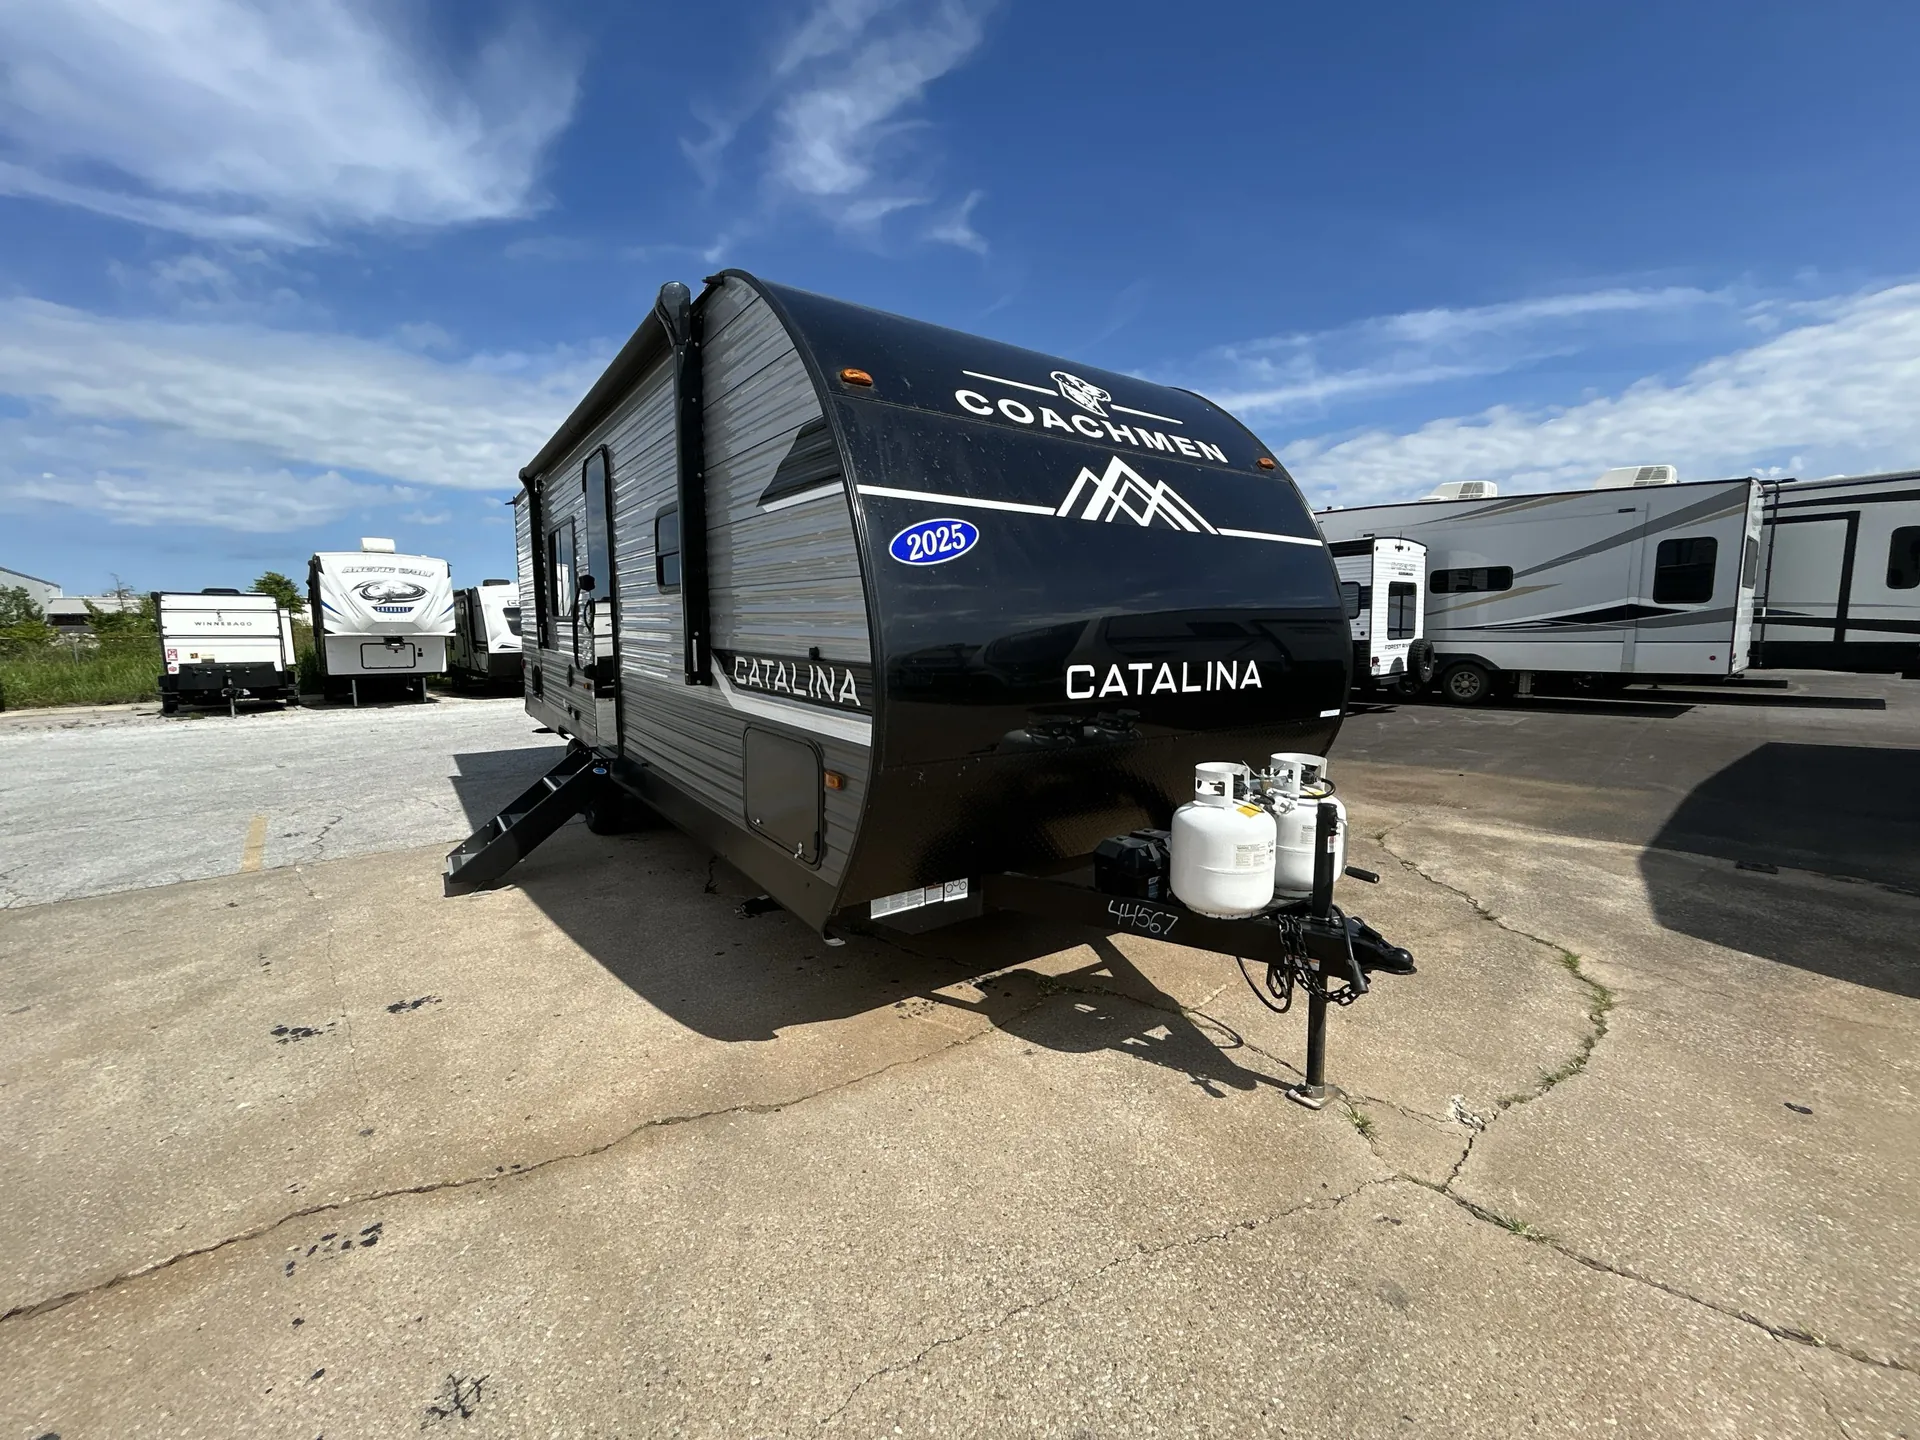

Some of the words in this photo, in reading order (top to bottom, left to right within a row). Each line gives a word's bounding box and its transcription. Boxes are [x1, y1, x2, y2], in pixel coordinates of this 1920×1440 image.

[955, 389, 1229, 463] COACHMEN
[906, 523, 966, 561] 2025
[342, 565, 396, 574] ARCTIC
[398, 567, 435, 577] WOLF
[734, 656, 862, 706] CATALINA
[1066, 660, 1263, 699] CATALINA
[1108, 900, 1179, 935] 44567
